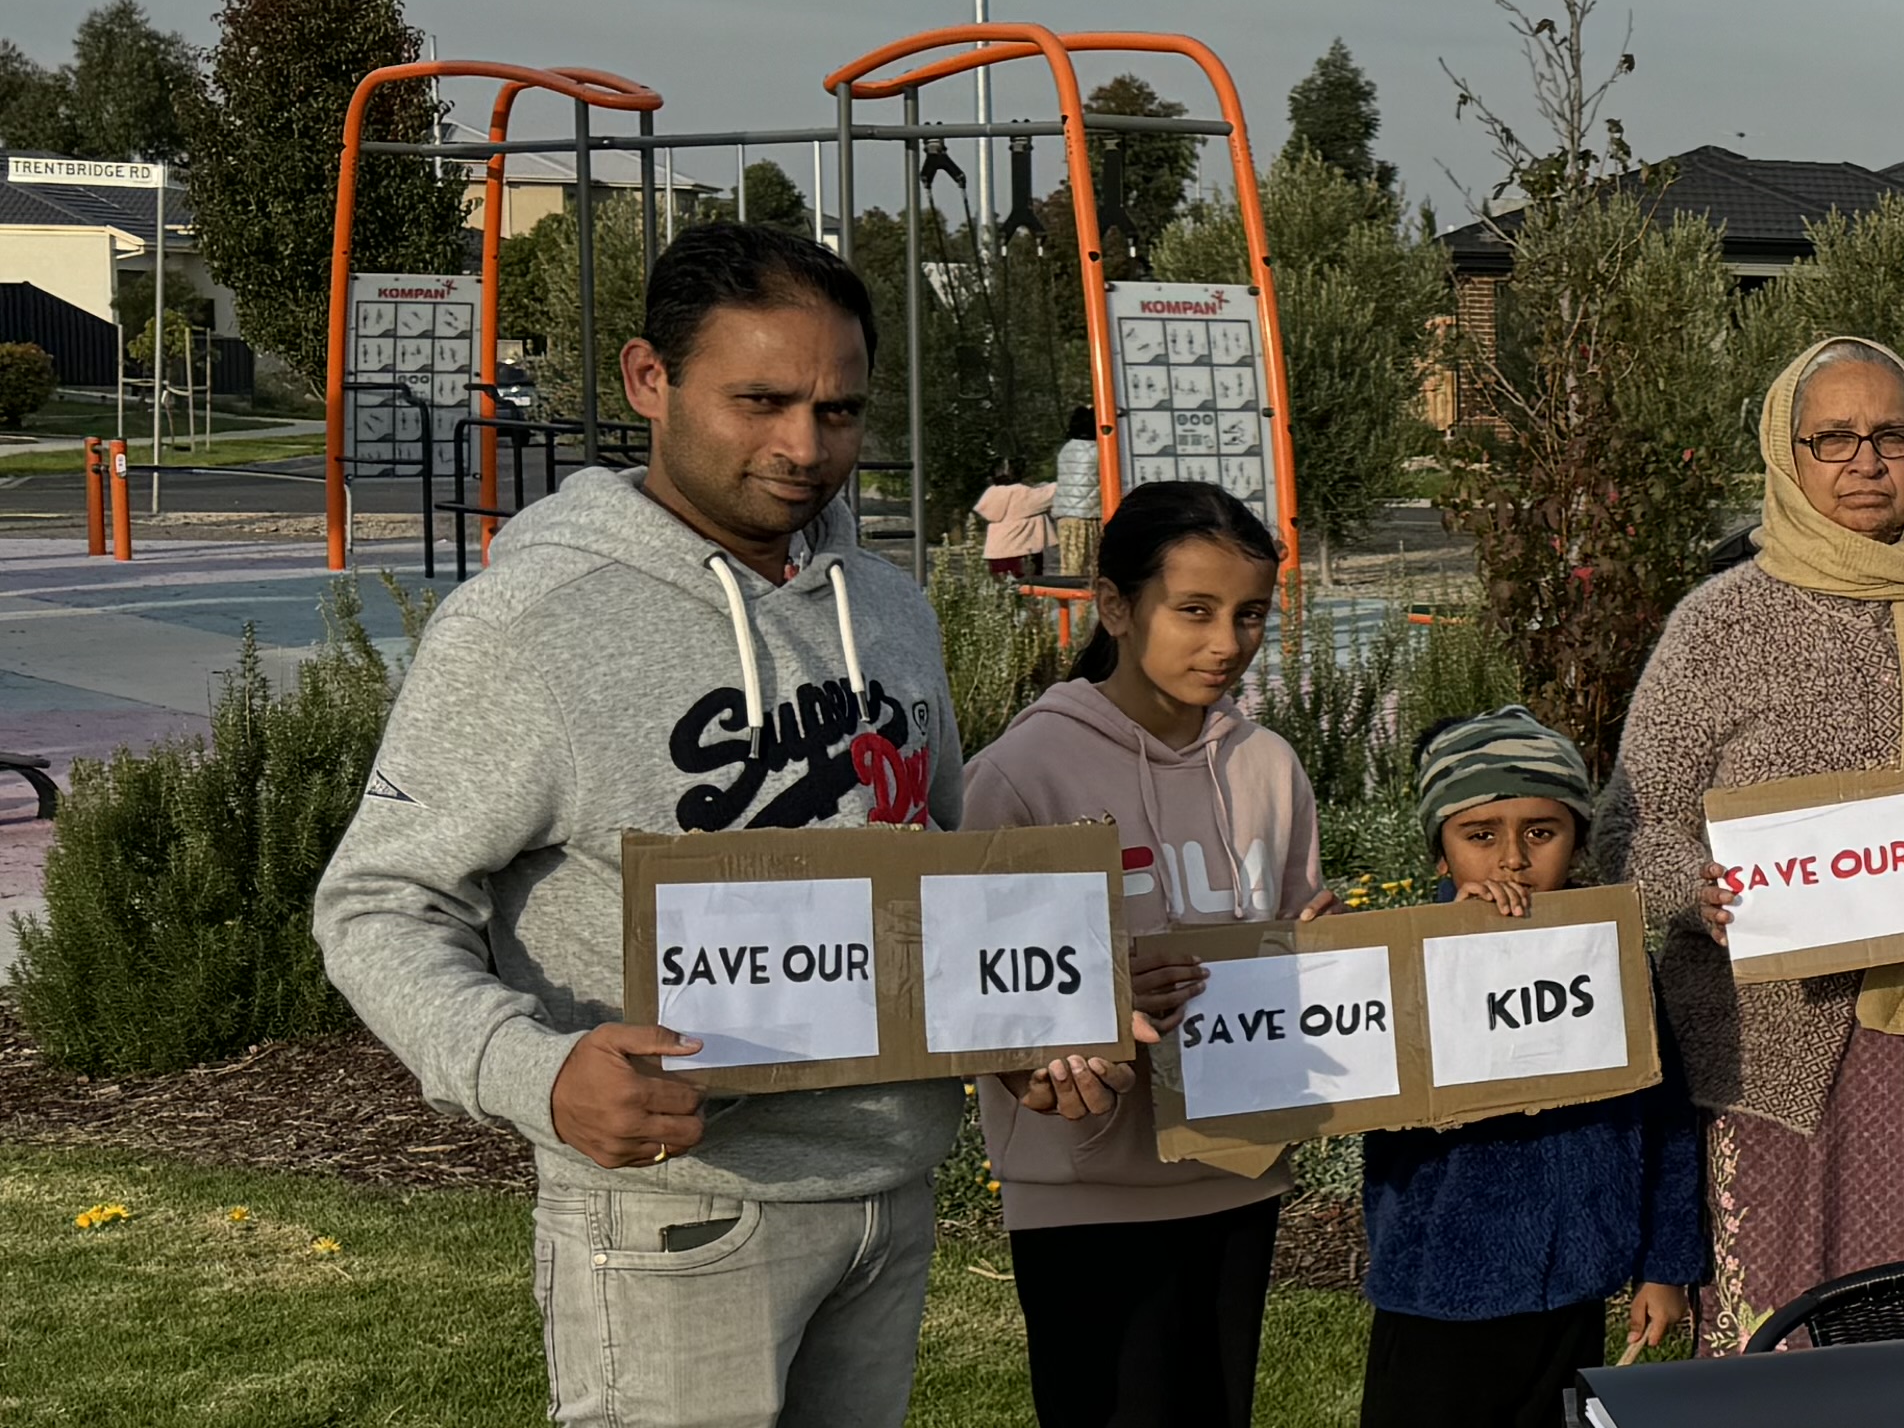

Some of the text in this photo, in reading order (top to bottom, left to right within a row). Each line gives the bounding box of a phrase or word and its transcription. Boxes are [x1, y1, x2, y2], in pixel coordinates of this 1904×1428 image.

[14, 160, 151, 179] TRENTBRIDGE RD
[377, 287, 446, 300] KOMPAN
[1140, 300, 1218, 316] KOMPAN
[1724, 856, 1820, 896] SAVE
[661, 943, 1082, 995] SAVE OUR KIDS
[1183, 974, 1594, 1049] SAVE OUR KIDS
